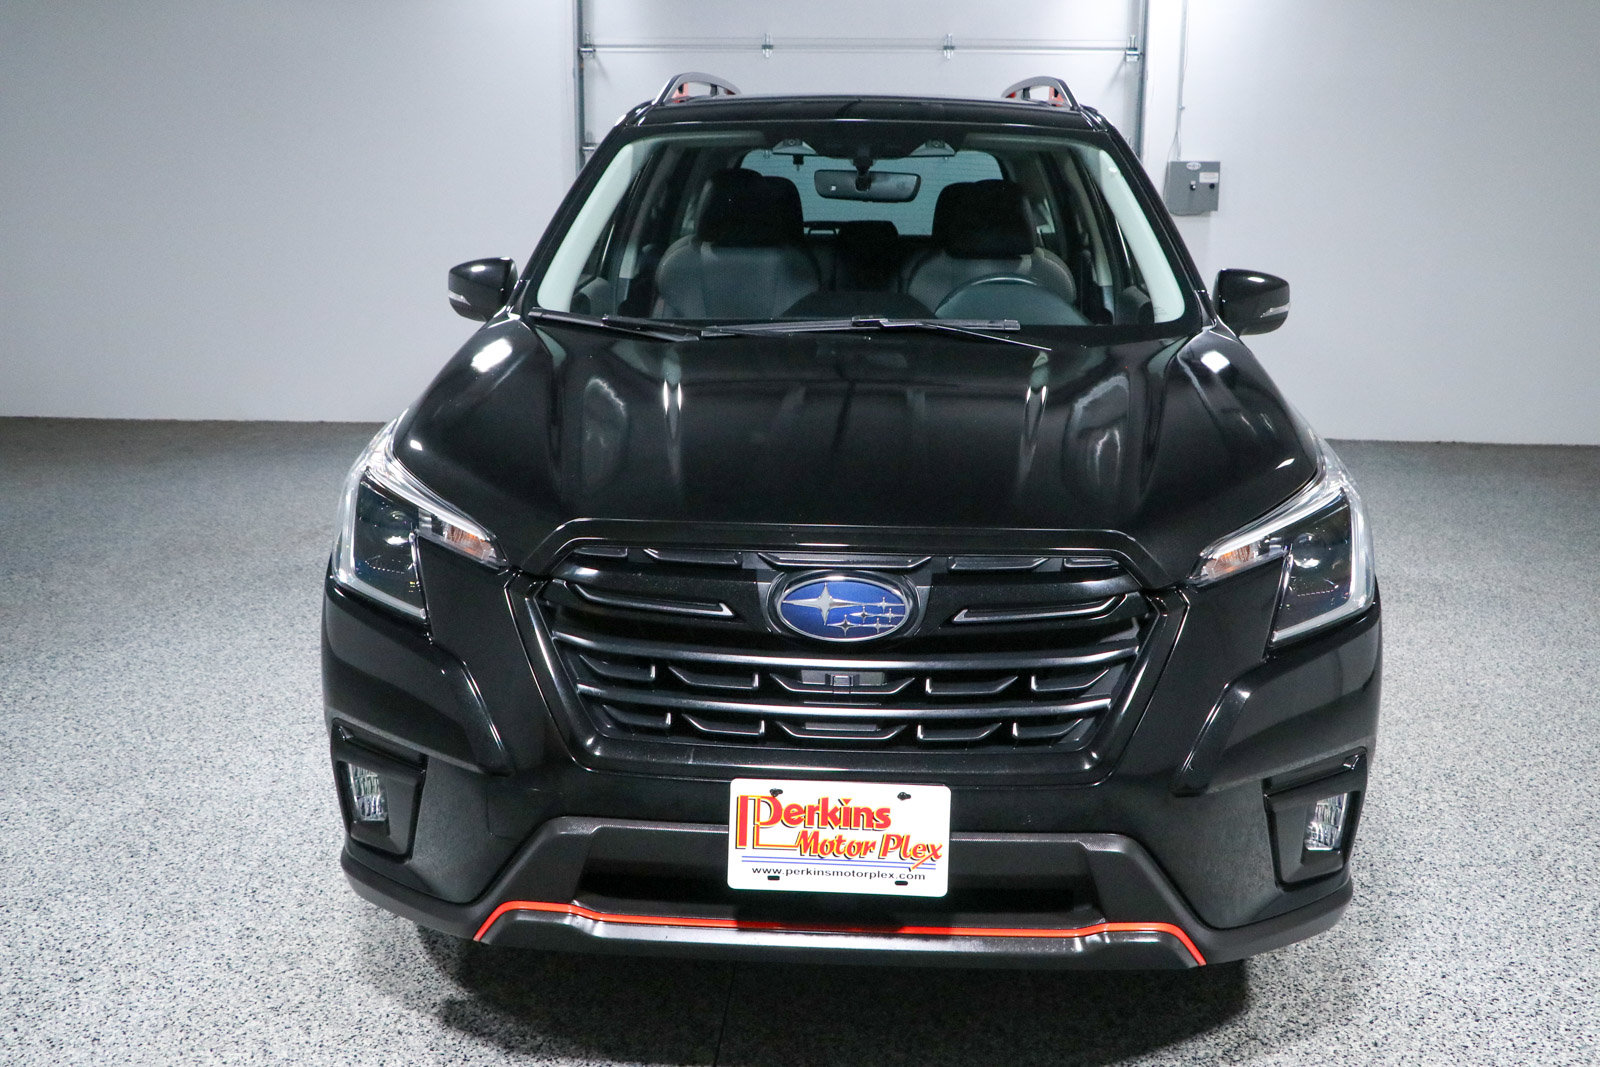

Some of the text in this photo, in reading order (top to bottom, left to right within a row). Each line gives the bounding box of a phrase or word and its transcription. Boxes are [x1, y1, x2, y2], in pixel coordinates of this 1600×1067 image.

[737, 795, 892, 848] Perkins
[798, 830, 943, 869] Motor Plex
[752, 866, 926, 880] www.perkinsmotorplex.com
